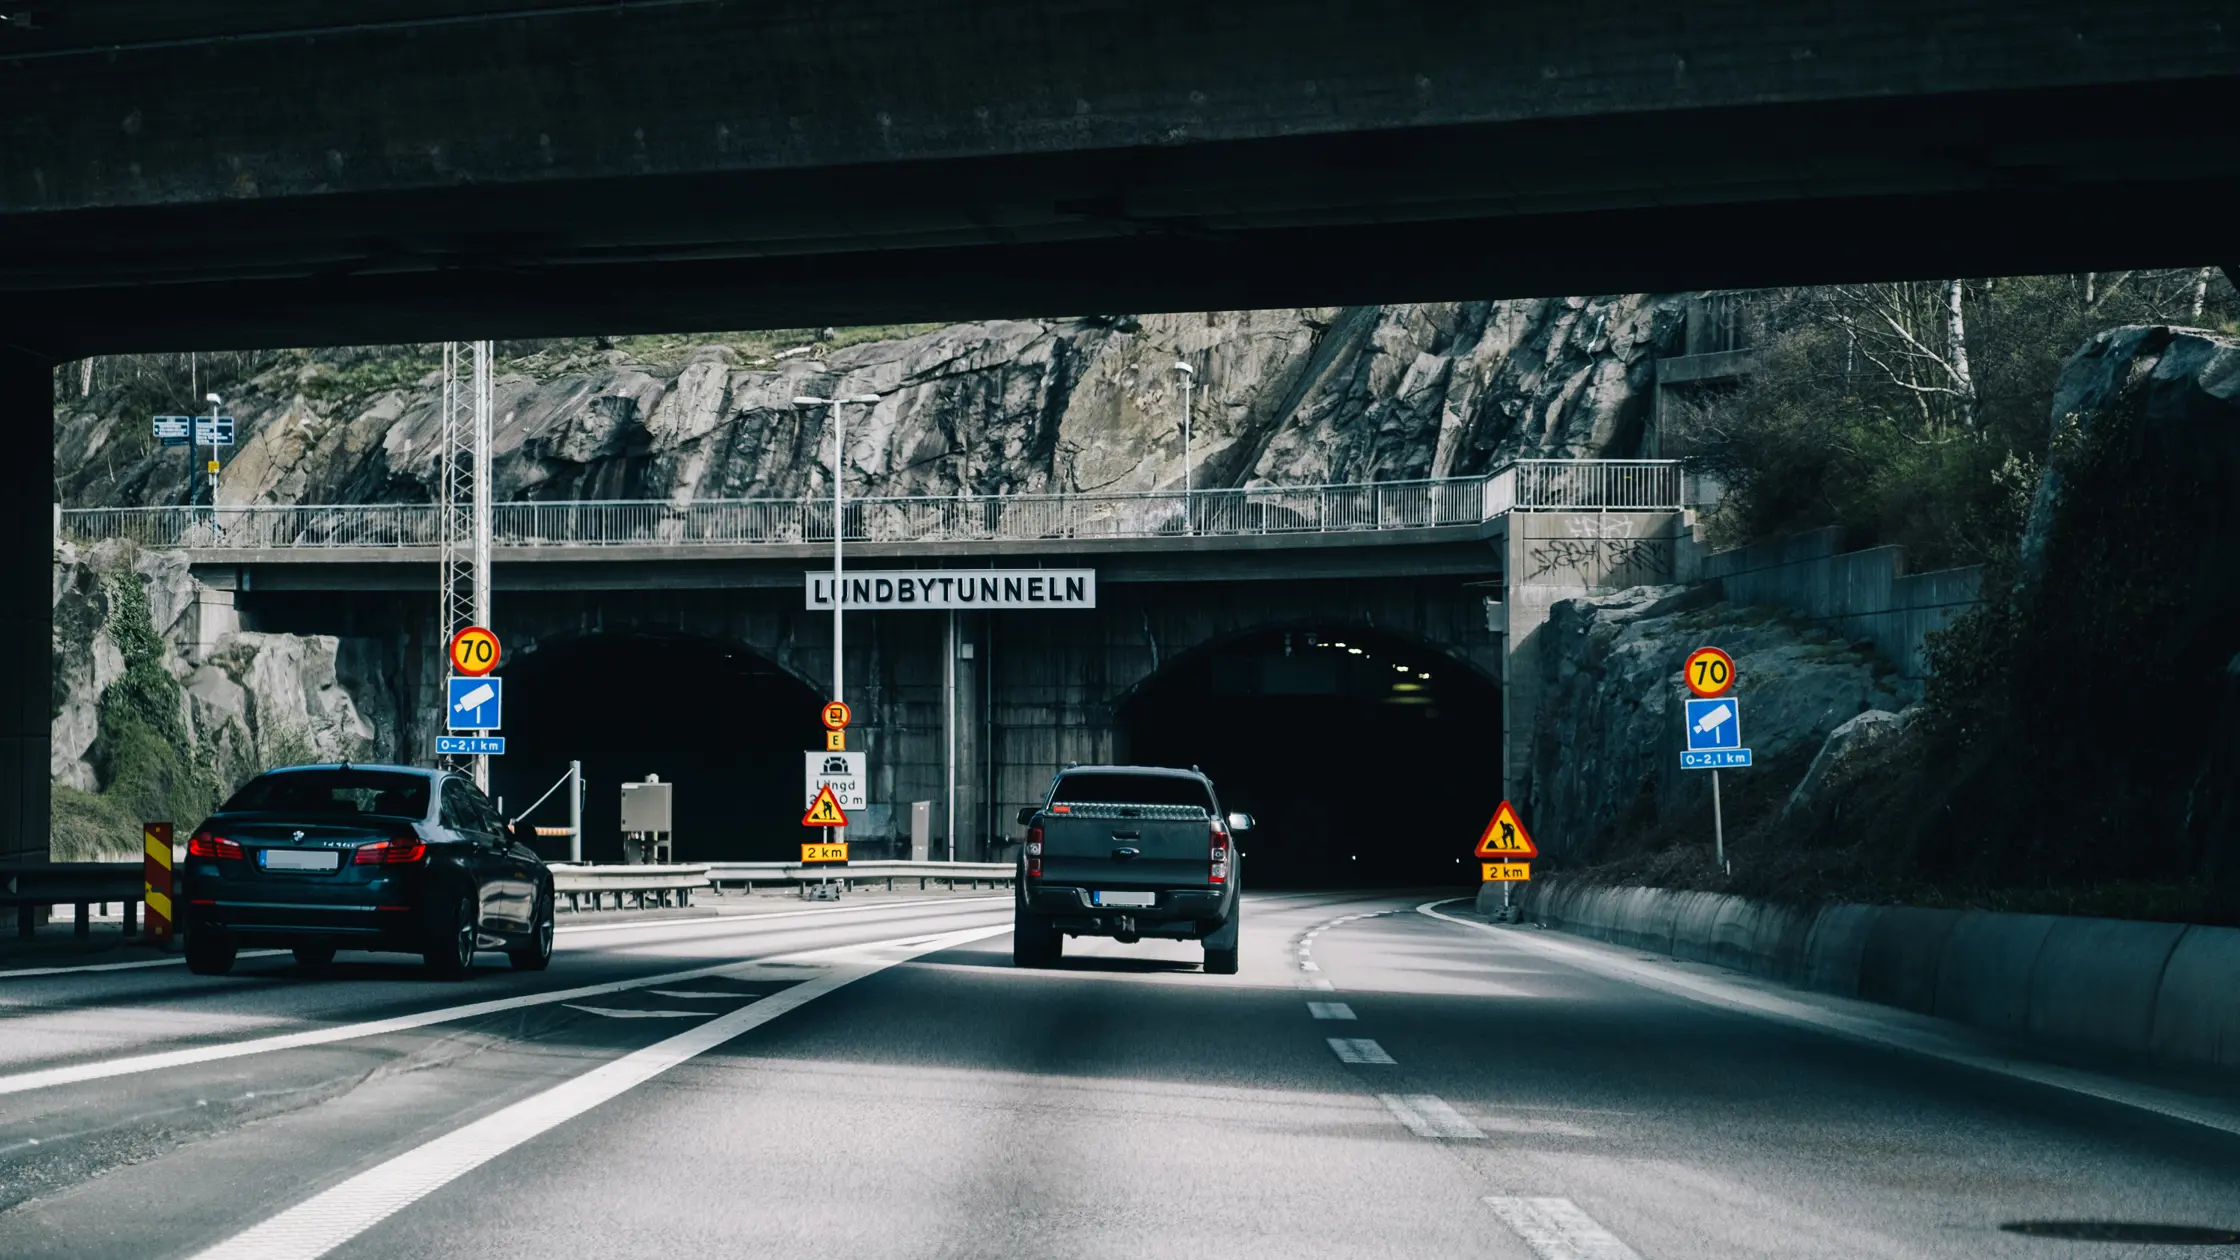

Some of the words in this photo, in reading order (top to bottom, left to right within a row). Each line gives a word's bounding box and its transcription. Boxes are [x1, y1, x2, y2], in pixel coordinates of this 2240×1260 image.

[814, 577, 1085, 603] LUNDBYTUNNELN
[461, 640, 493, 663] 70
[1695, 660, 1727, 685] 70
[441, 740, 476, 752] 0-2,1
[480, 741, 498, 750] km
[832, 735, 840, 745] E
[1686, 753, 1721, 765] 0-2,1
[1726, 753, 1745, 763] km
[810, 794, 848, 805] 20
[808, 847, 816, 858] 2
[822, 848, 842, 857] km
[1490, 866, 1498, 878] 2
[1503, 866, 1522, 877] km
